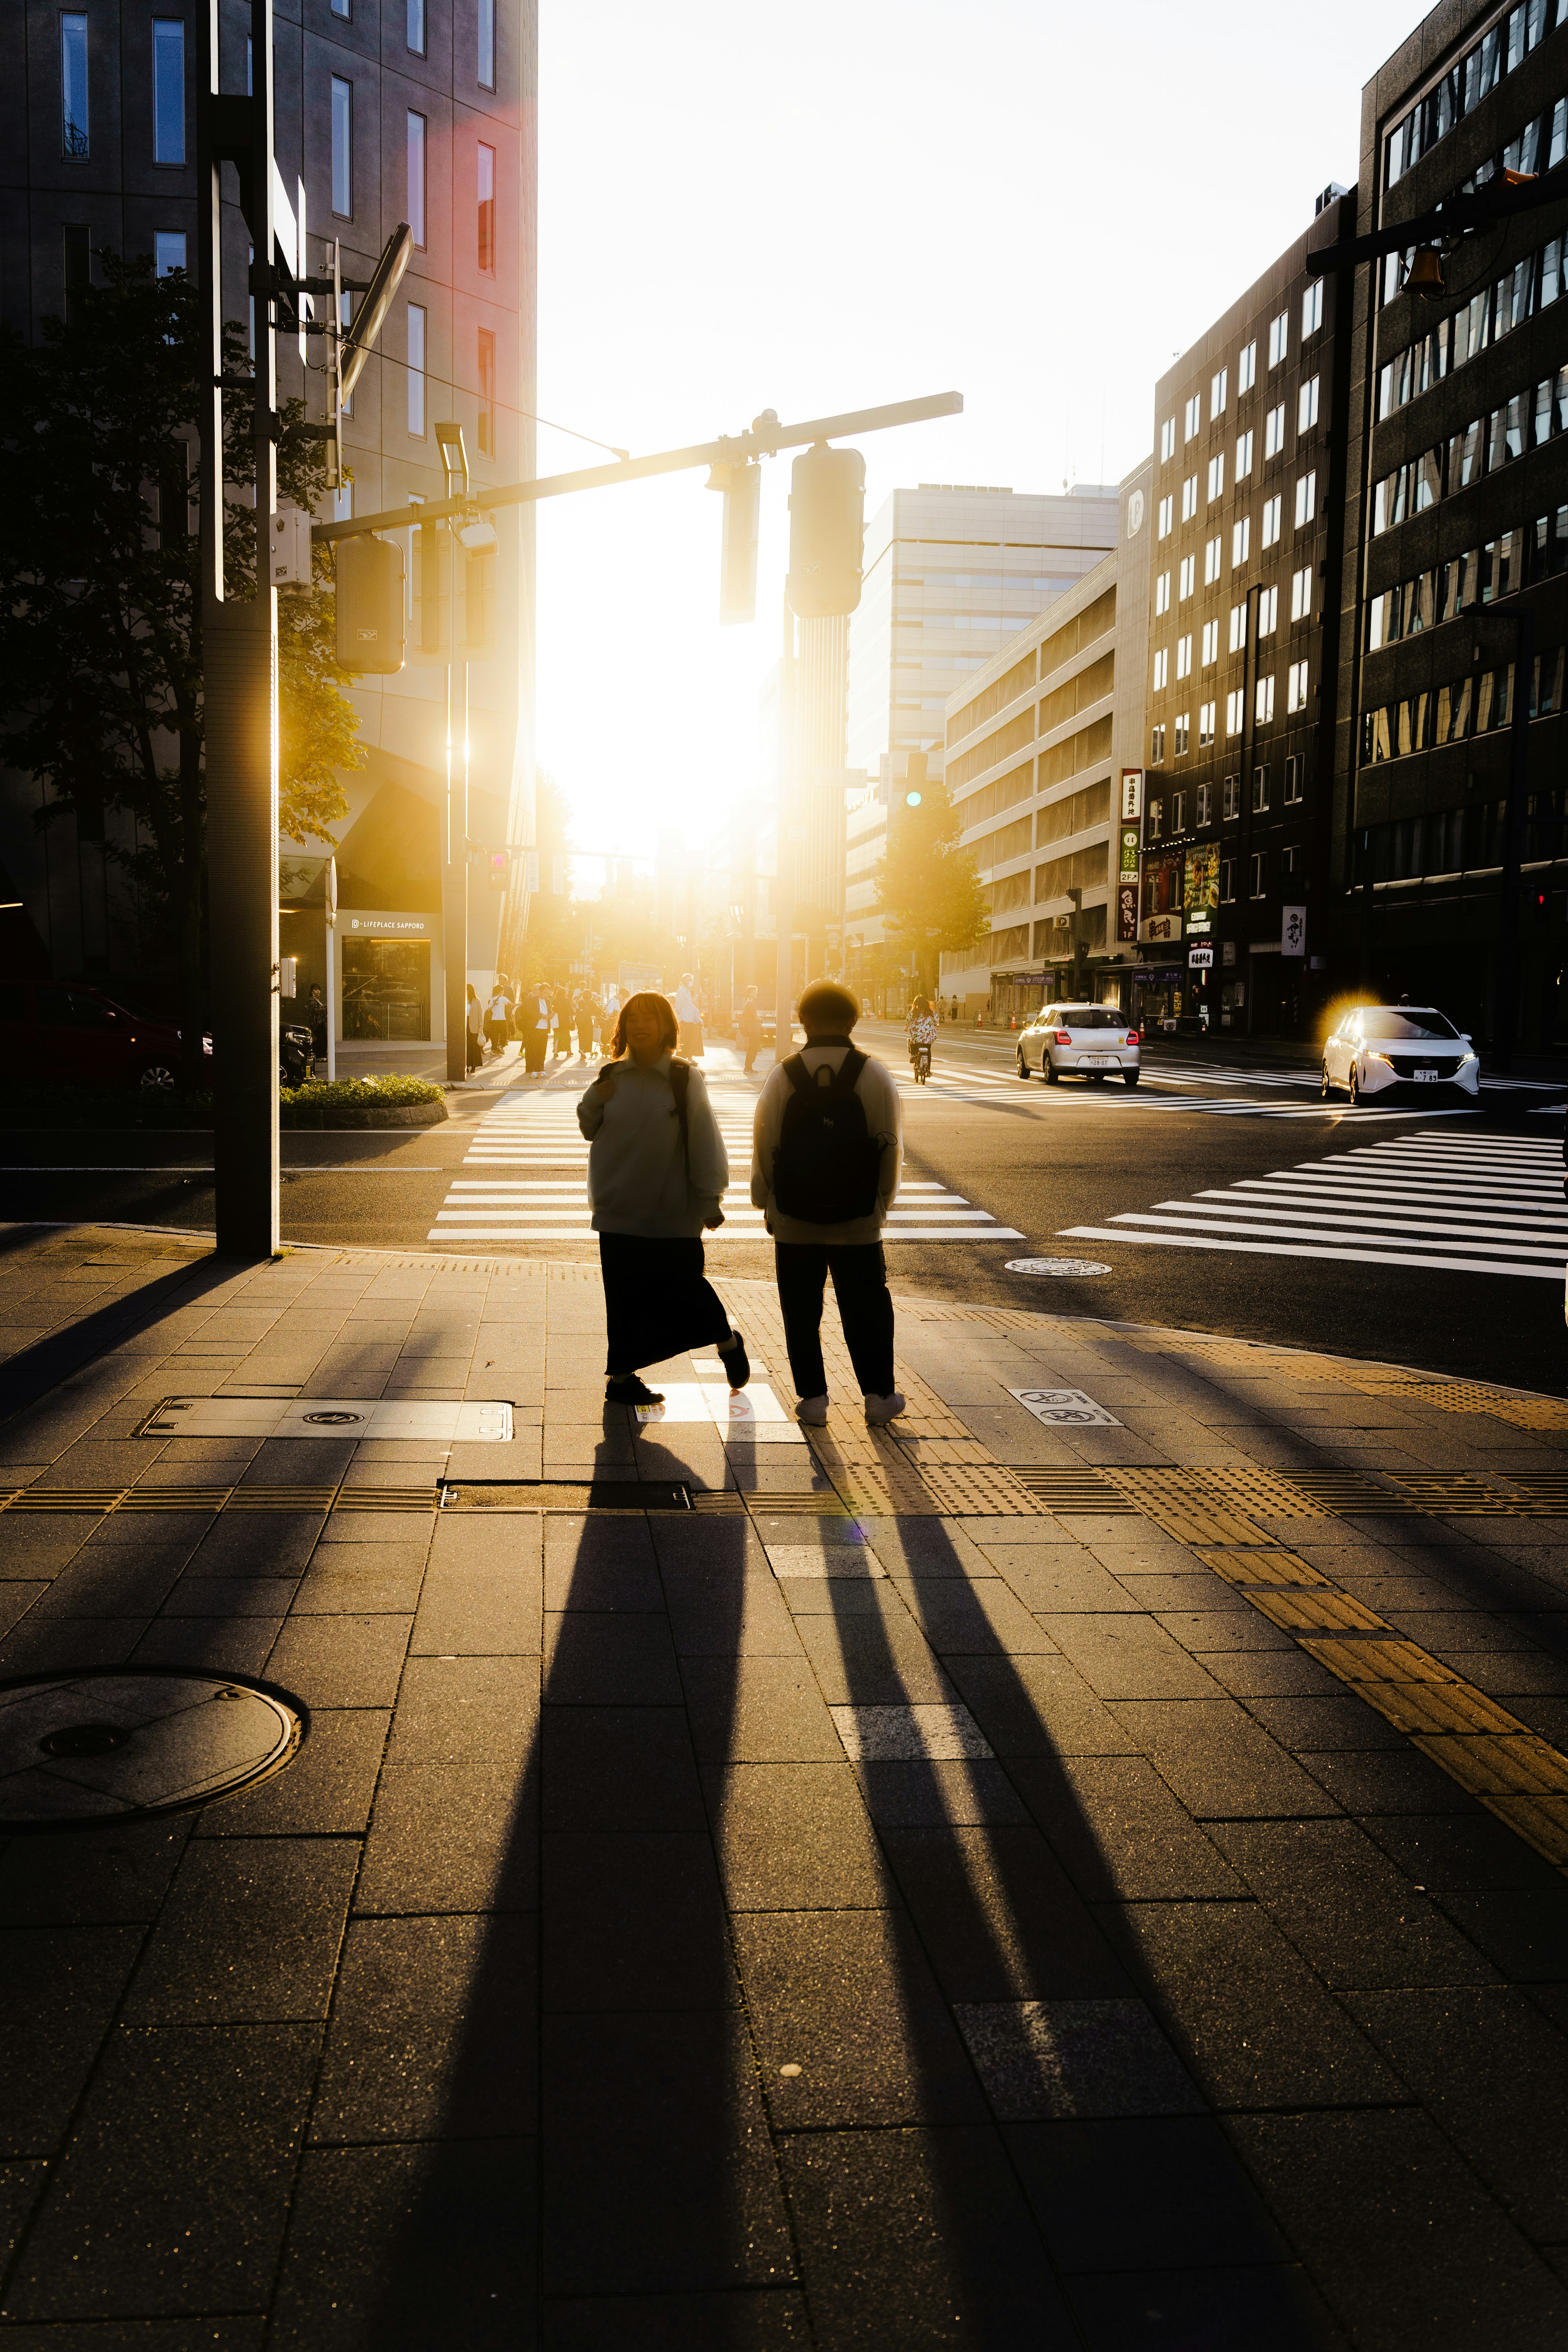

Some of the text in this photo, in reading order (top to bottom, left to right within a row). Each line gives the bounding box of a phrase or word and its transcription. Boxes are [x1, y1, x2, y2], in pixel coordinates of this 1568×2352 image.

[1127, 777, 1136, 815] 串鳥番外地
[1121, 889, 1136, 924] 魚民
[1074, 1395, 1091, 1405] SMOKING
[1096, 1412, 1115, 1423] LITTERING
